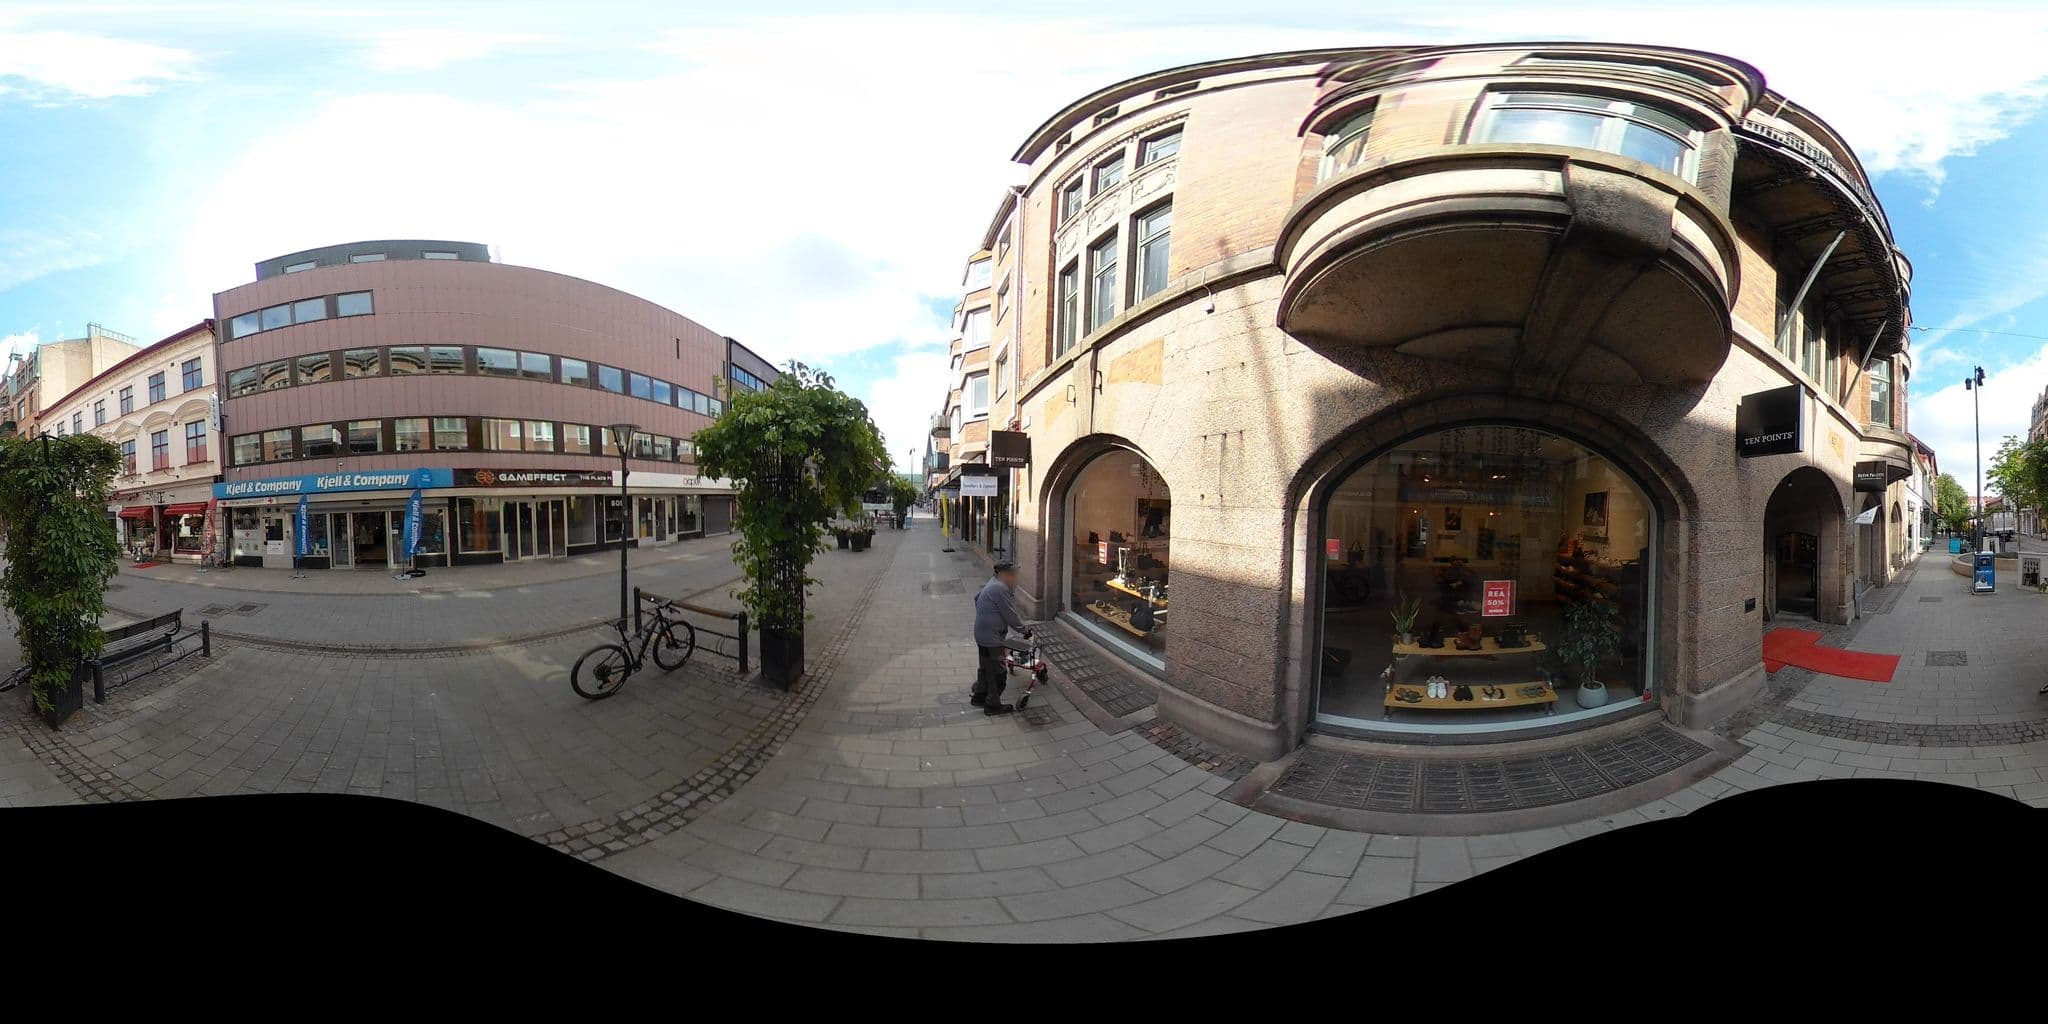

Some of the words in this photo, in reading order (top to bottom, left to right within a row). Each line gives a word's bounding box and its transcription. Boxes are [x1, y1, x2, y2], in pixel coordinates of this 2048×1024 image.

[1744, 436, 1760, 445] TEN
[1762, 431, 1793, 443] POINTS
[317, 474, 342, 489] Kjell
[343, 474, 352, 486] &
[353, 474, 410, 487] Company
[498, 473, 567, 482] GAMEFFECT
[226, 482, 247, 495] Kjell
[247, 482, 254, 492] &
[255, 479, 302, 493] Company
